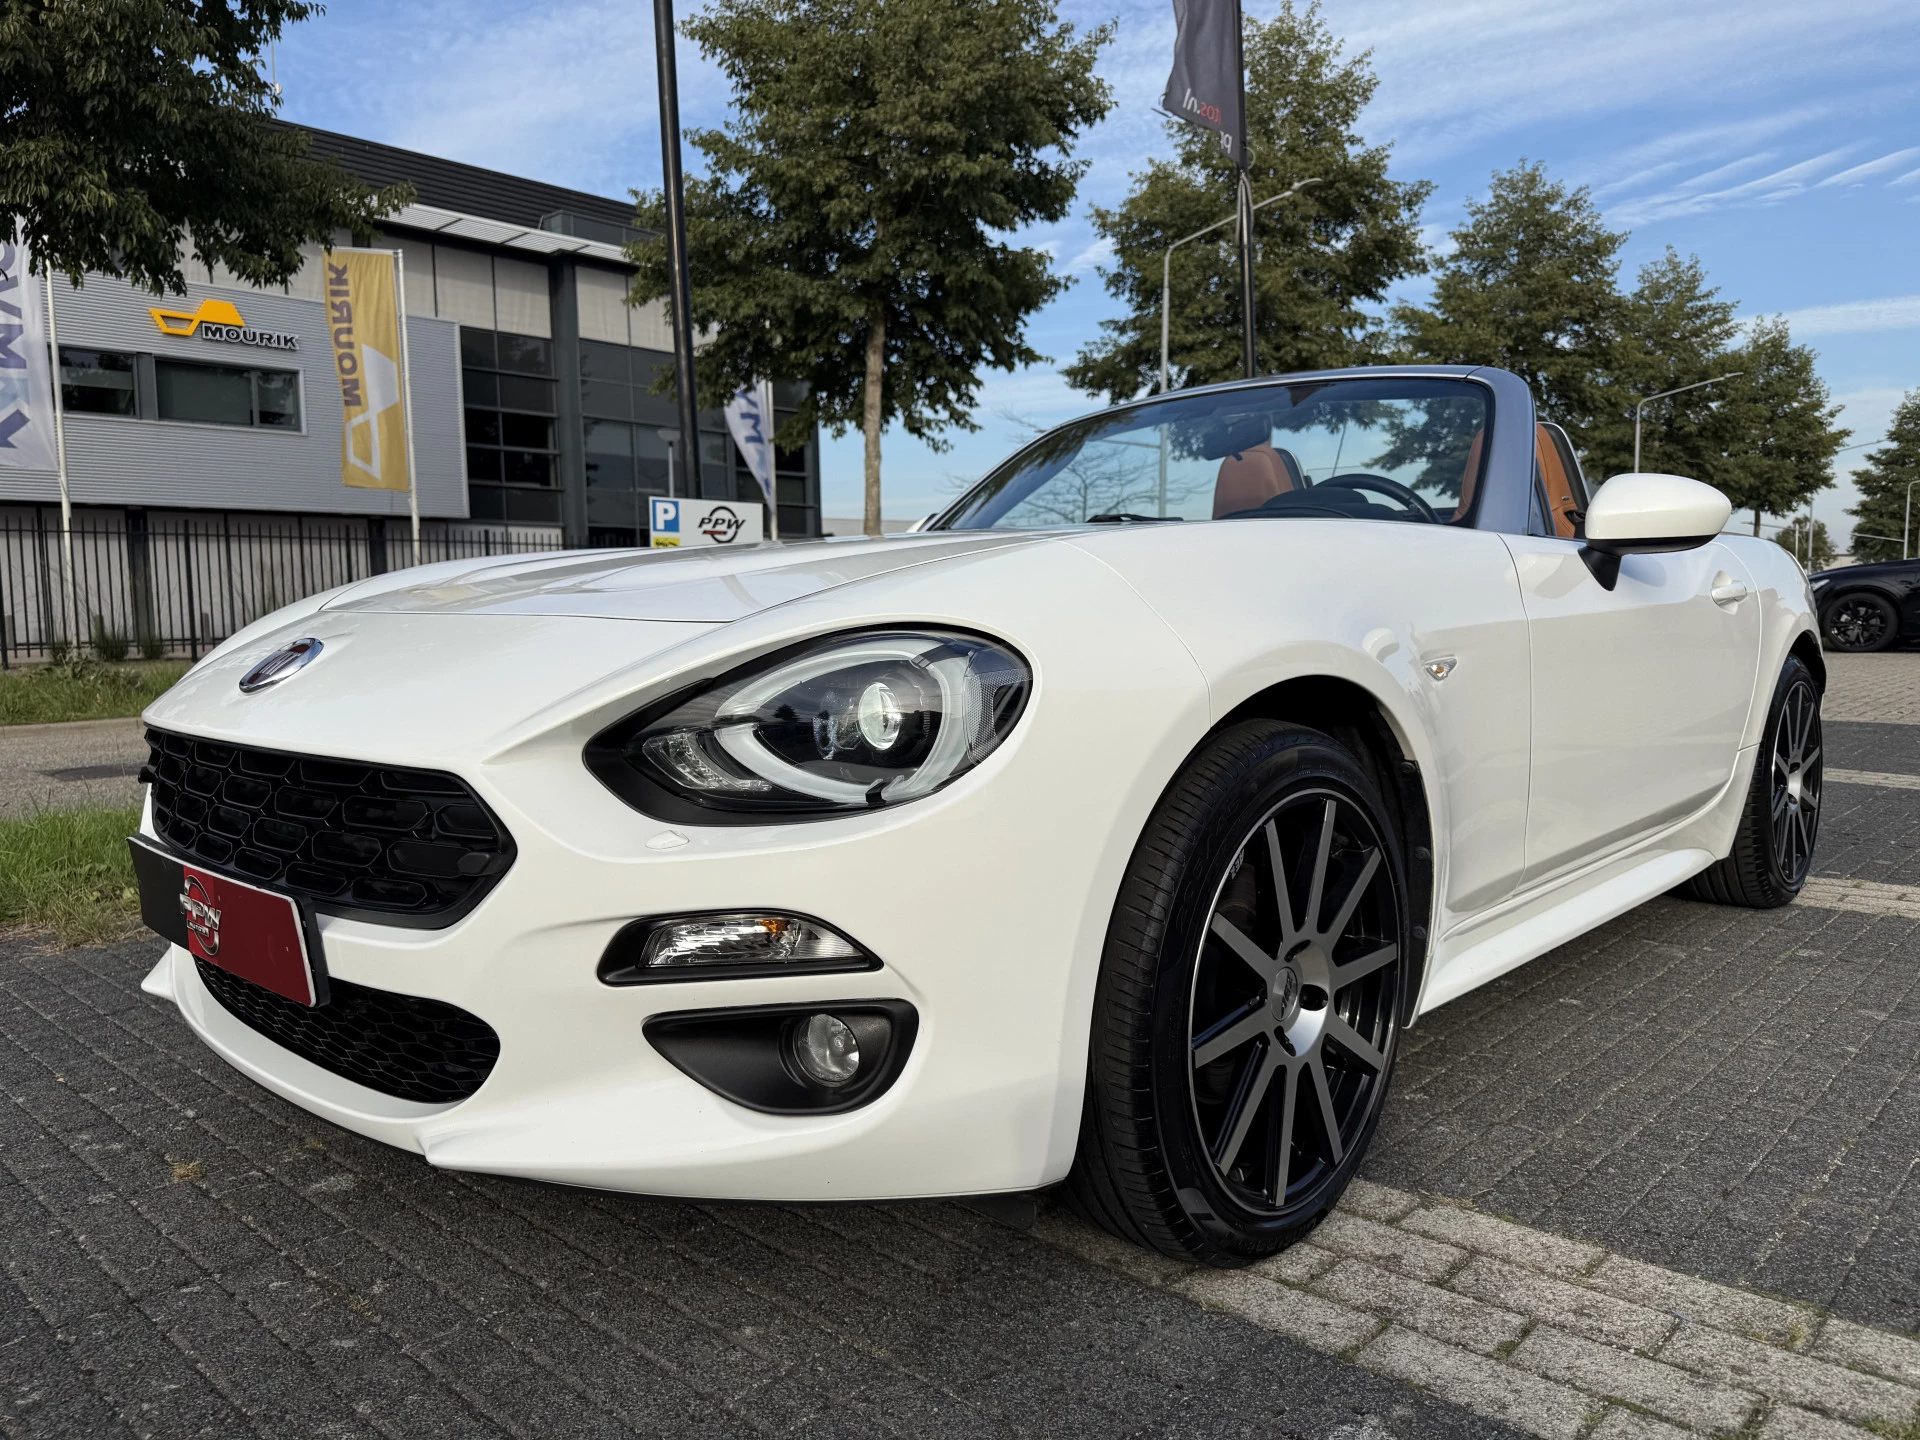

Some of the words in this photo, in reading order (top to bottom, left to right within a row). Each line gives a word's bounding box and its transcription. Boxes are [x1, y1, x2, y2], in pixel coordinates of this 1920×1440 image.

[203, 323, 299, 350] MOURIK
[655, 502, 677, 530] P
[698, 517, 746, 530] PPW
[179, 893, 222, 931] PPW
